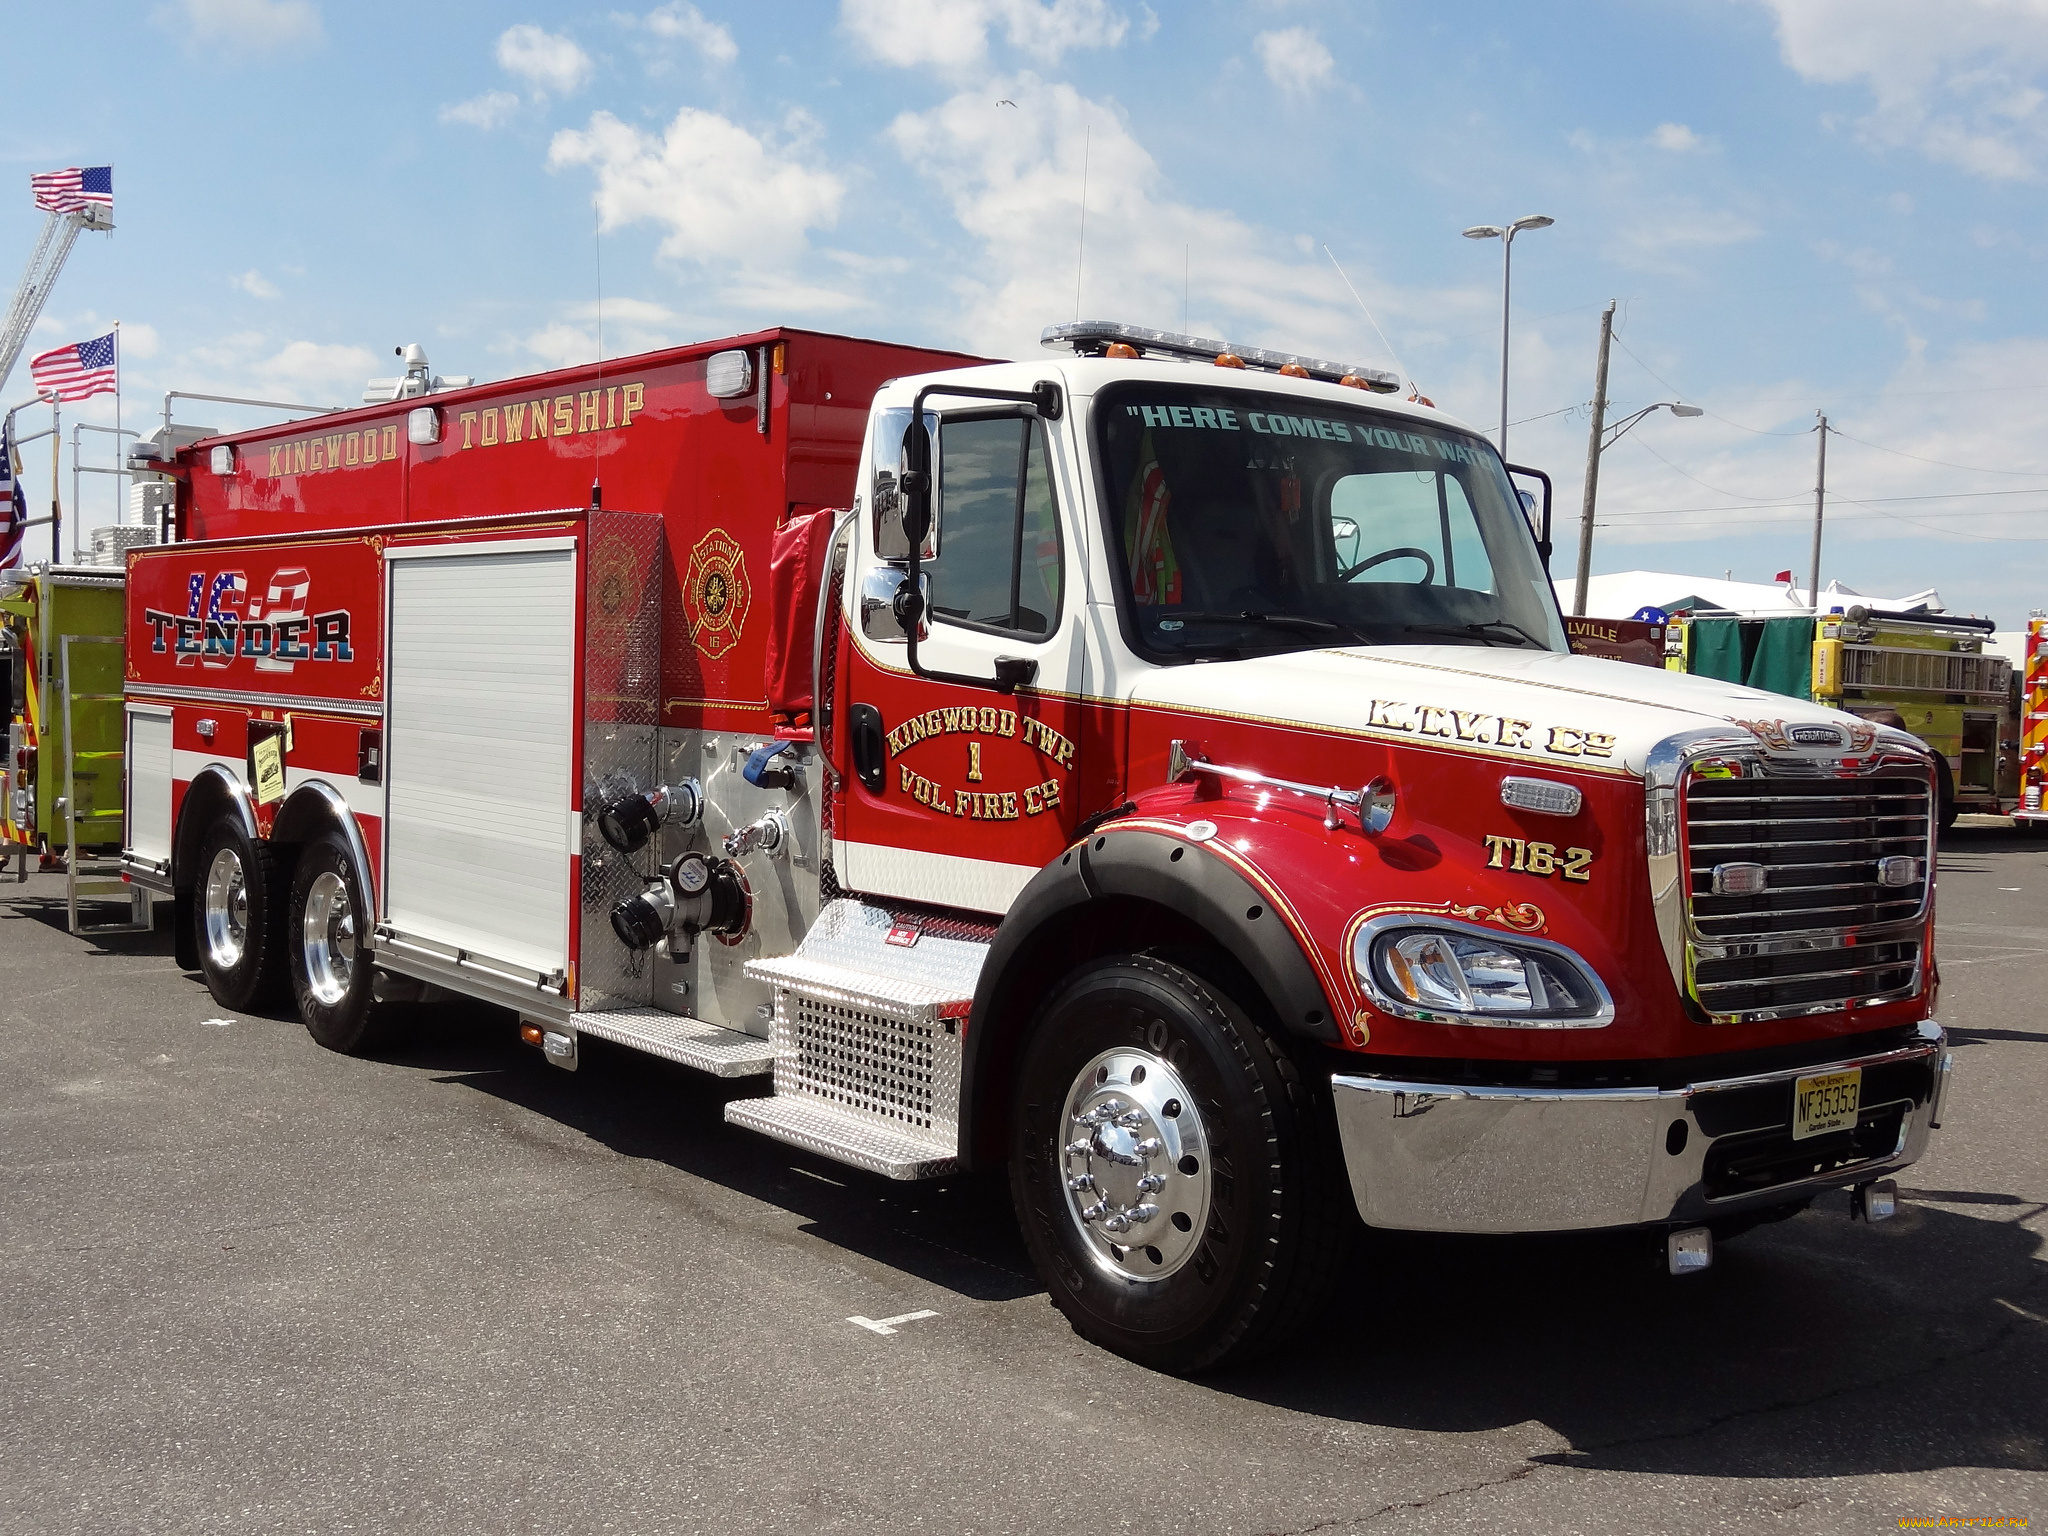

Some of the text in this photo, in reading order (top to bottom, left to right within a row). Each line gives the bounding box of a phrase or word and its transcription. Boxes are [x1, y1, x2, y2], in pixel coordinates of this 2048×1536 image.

[268, 382, 646, 478] KINGWOOD TOWNSHIP
[1248, 412, 1352, 443] COMES
[1355, 425, 1431, 456] YOUR
[700, 540, 734, 560] STATION
[145, 607, 354, 663] TENDER
[709, 636, 720, 648] 16
[885, 706, 1075, 771] KINGWOOD TWP.
[967, 742, 983, 782] 1
[900, 763, 951, 814] VOL.
[954, 789, 1020, 820] FIRE
[1484, 834, 1593, 883] T16-2
[895, 922, 918, 931] CAUTION
[1799, 1084, 1857, 1123] NF35353
[1809, 1119, 1841, 1132] Garden State
